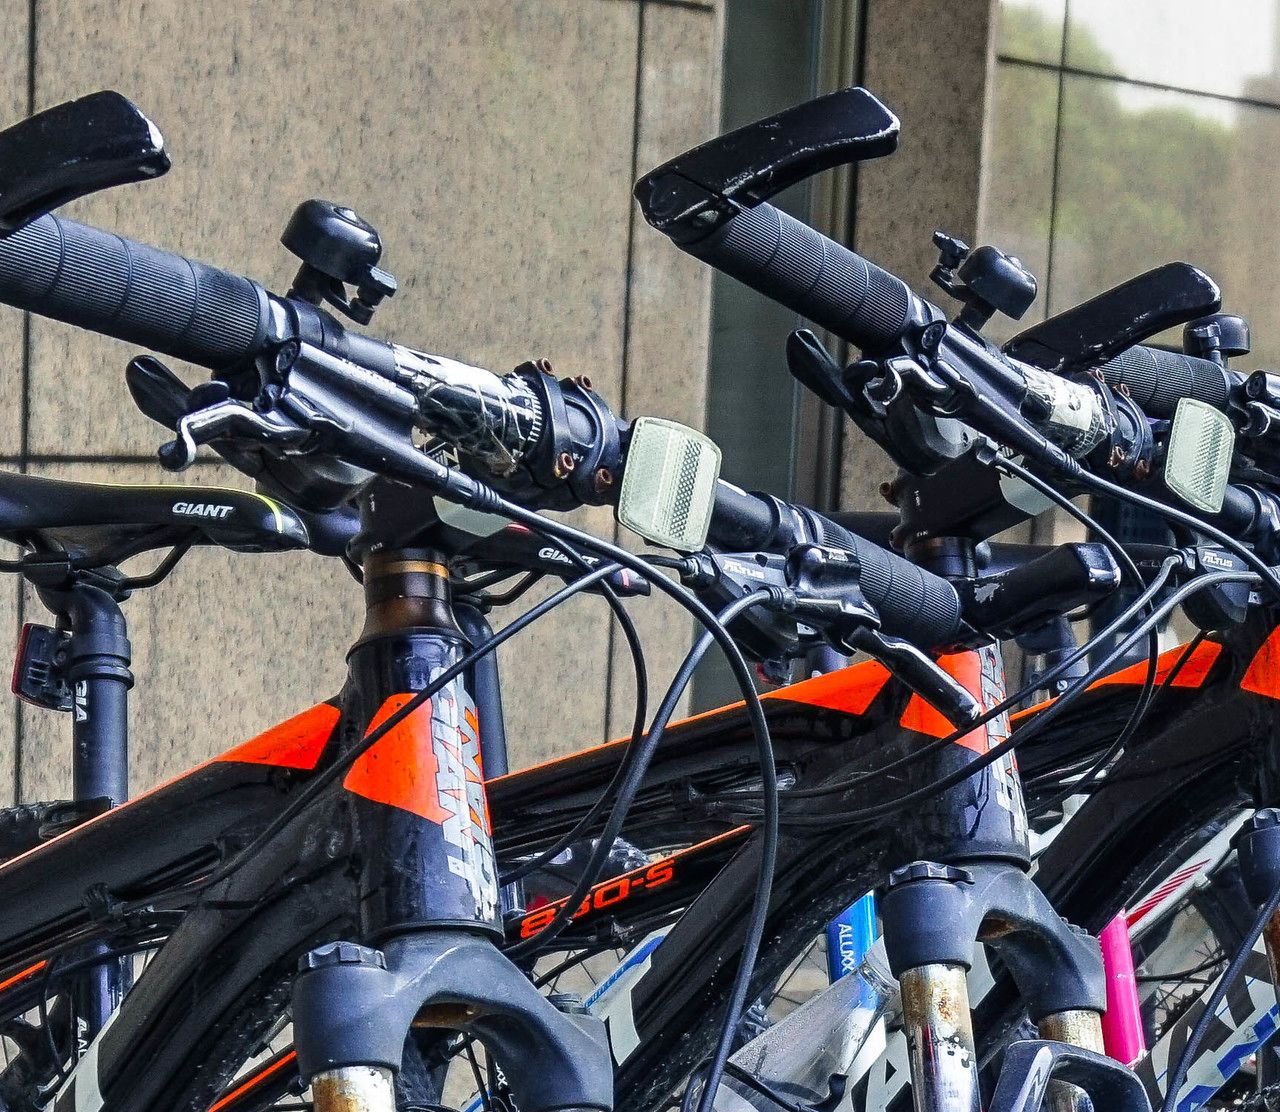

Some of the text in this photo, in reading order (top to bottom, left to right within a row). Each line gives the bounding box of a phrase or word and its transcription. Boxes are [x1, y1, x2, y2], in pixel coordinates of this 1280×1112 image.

[172, 502, 234, 519] GIANT
[538, 547, 599, 566] GIAT
[1202, 554, 1233, 568] ALTUS
[837, 923, 857, 974] ALUXX
